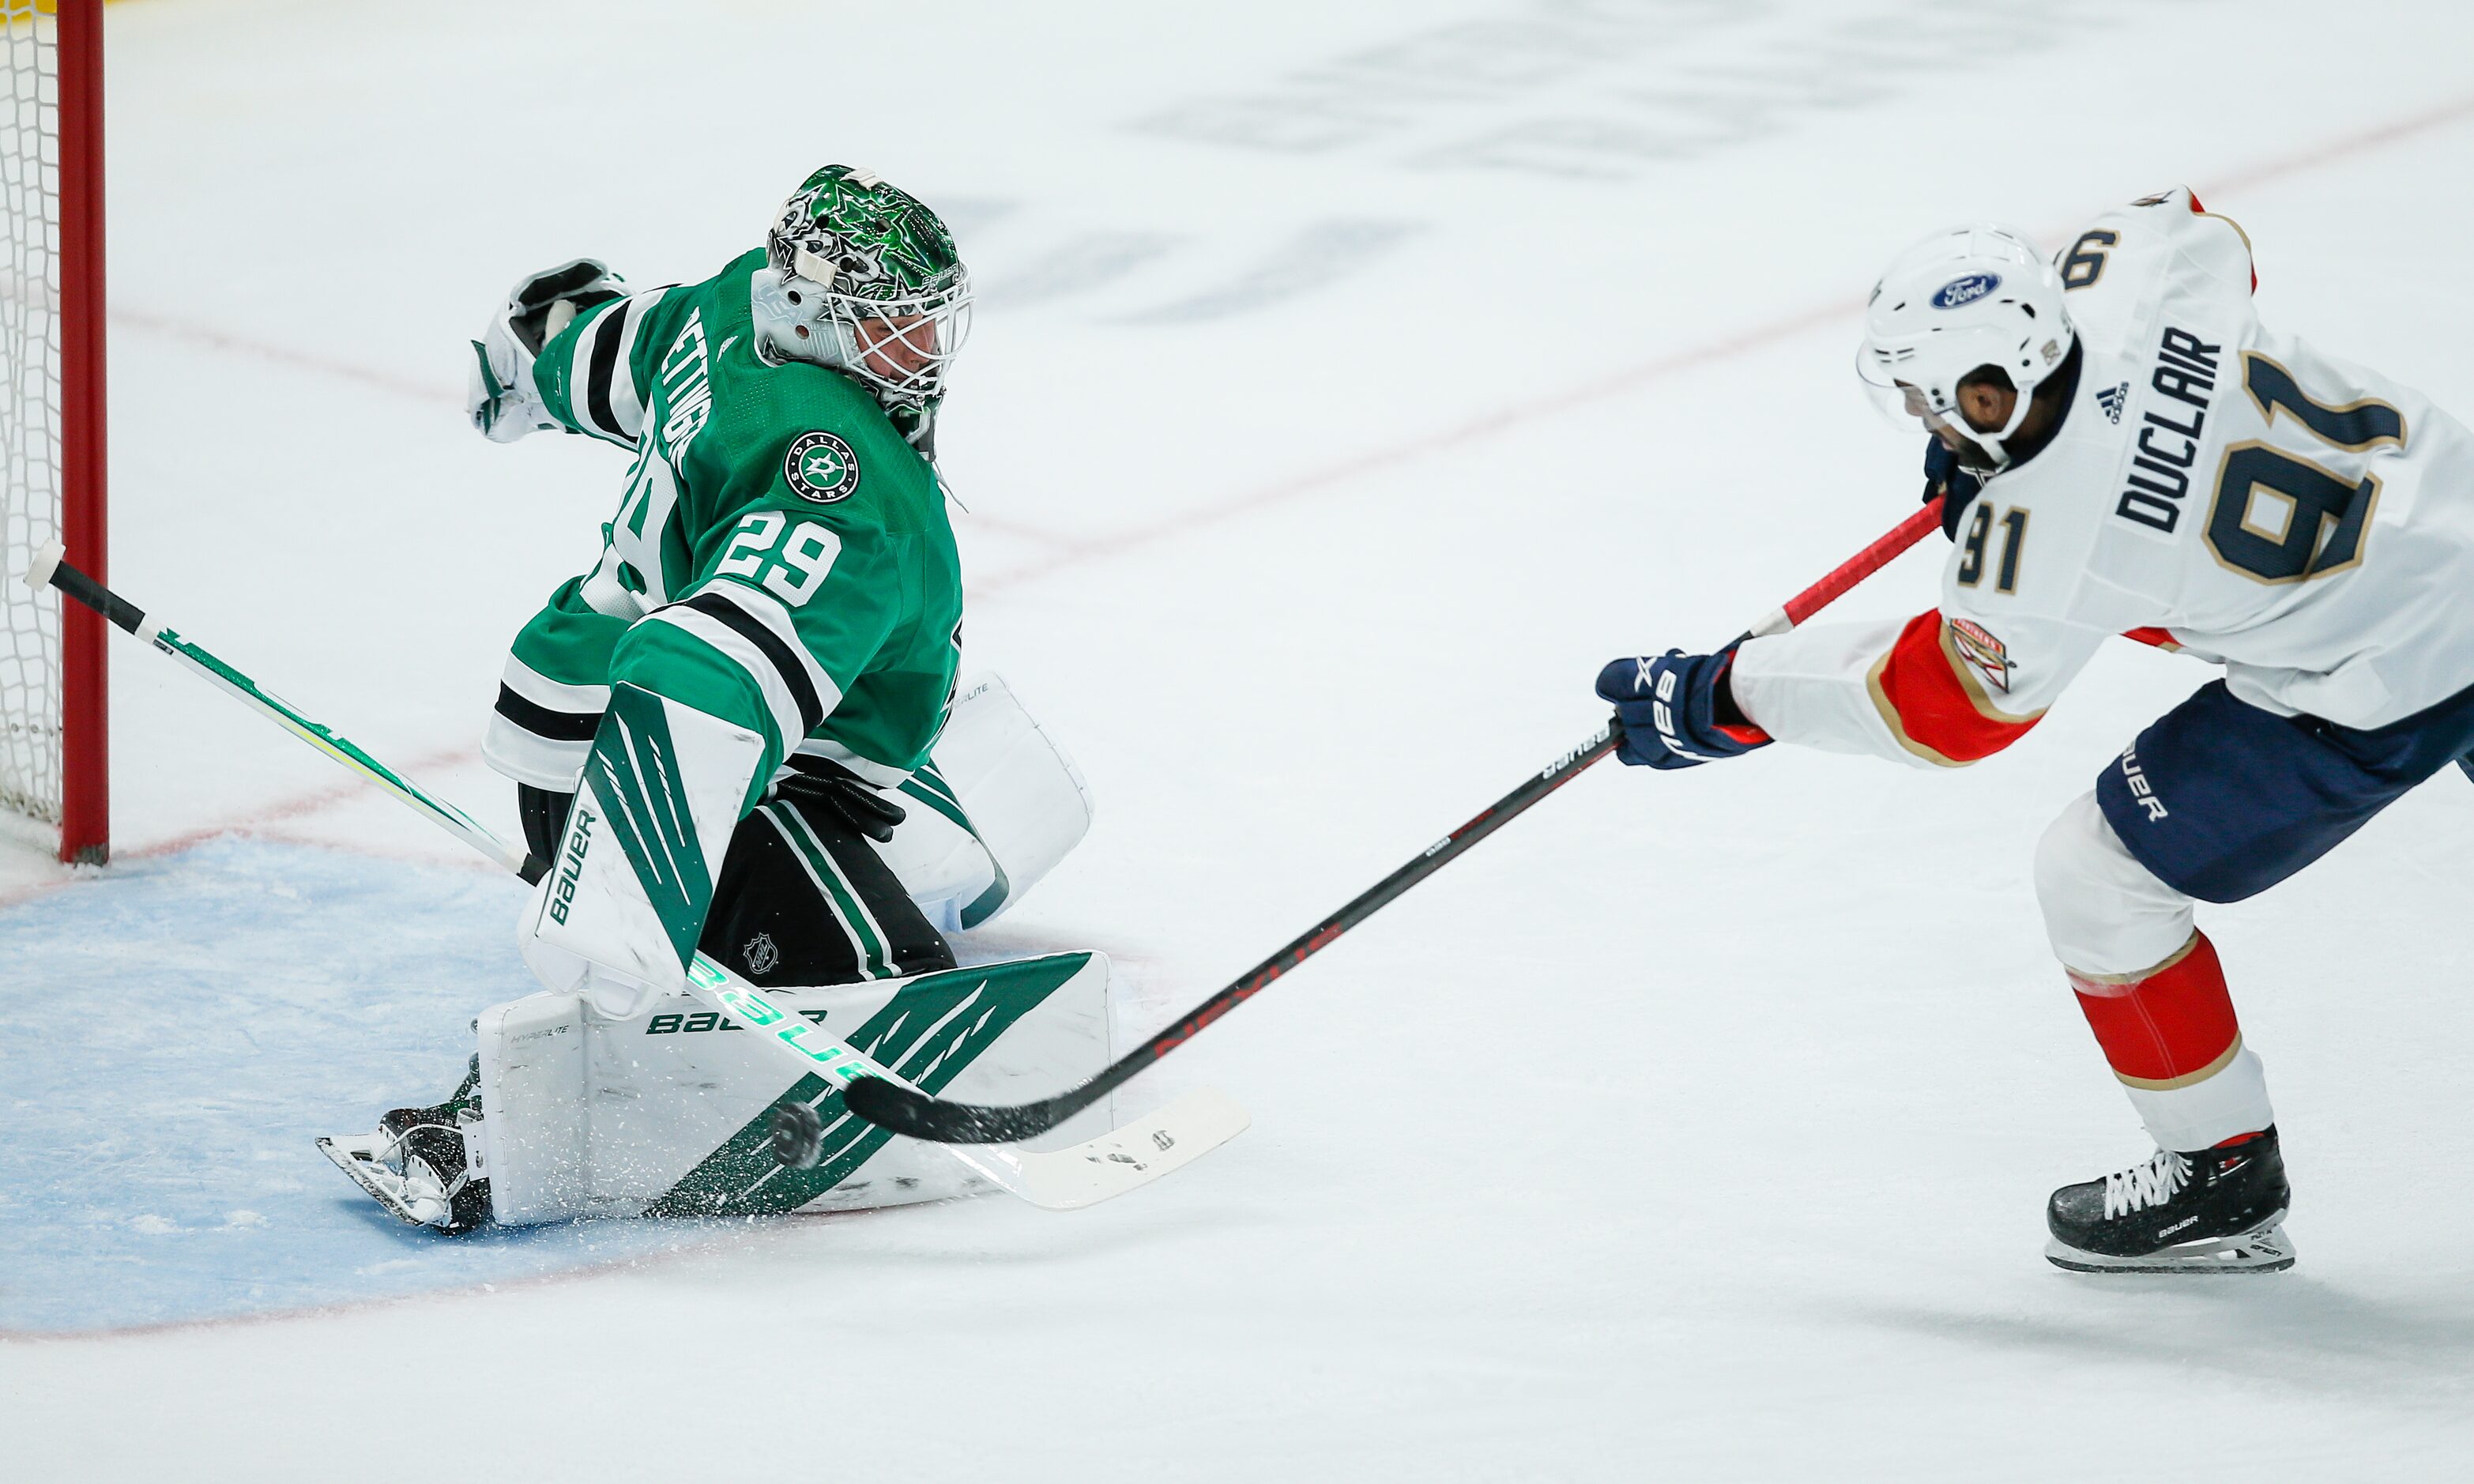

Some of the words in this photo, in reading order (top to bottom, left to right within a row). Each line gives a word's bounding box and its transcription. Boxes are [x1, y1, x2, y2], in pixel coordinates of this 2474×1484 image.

[1943, 277, 1988, 307] Ford
[2111, 381, 2129, 425] adidas
[2115, 326, 2222, 535] DUCLAIR
[790, 472, 849, 499] STARS
[793, 435, 856, 472] DALLAS
[2200, 348, 2408, 587] 91
[713, 510, 843, 608] 29
[1957, 501, 2032, 596] 91
